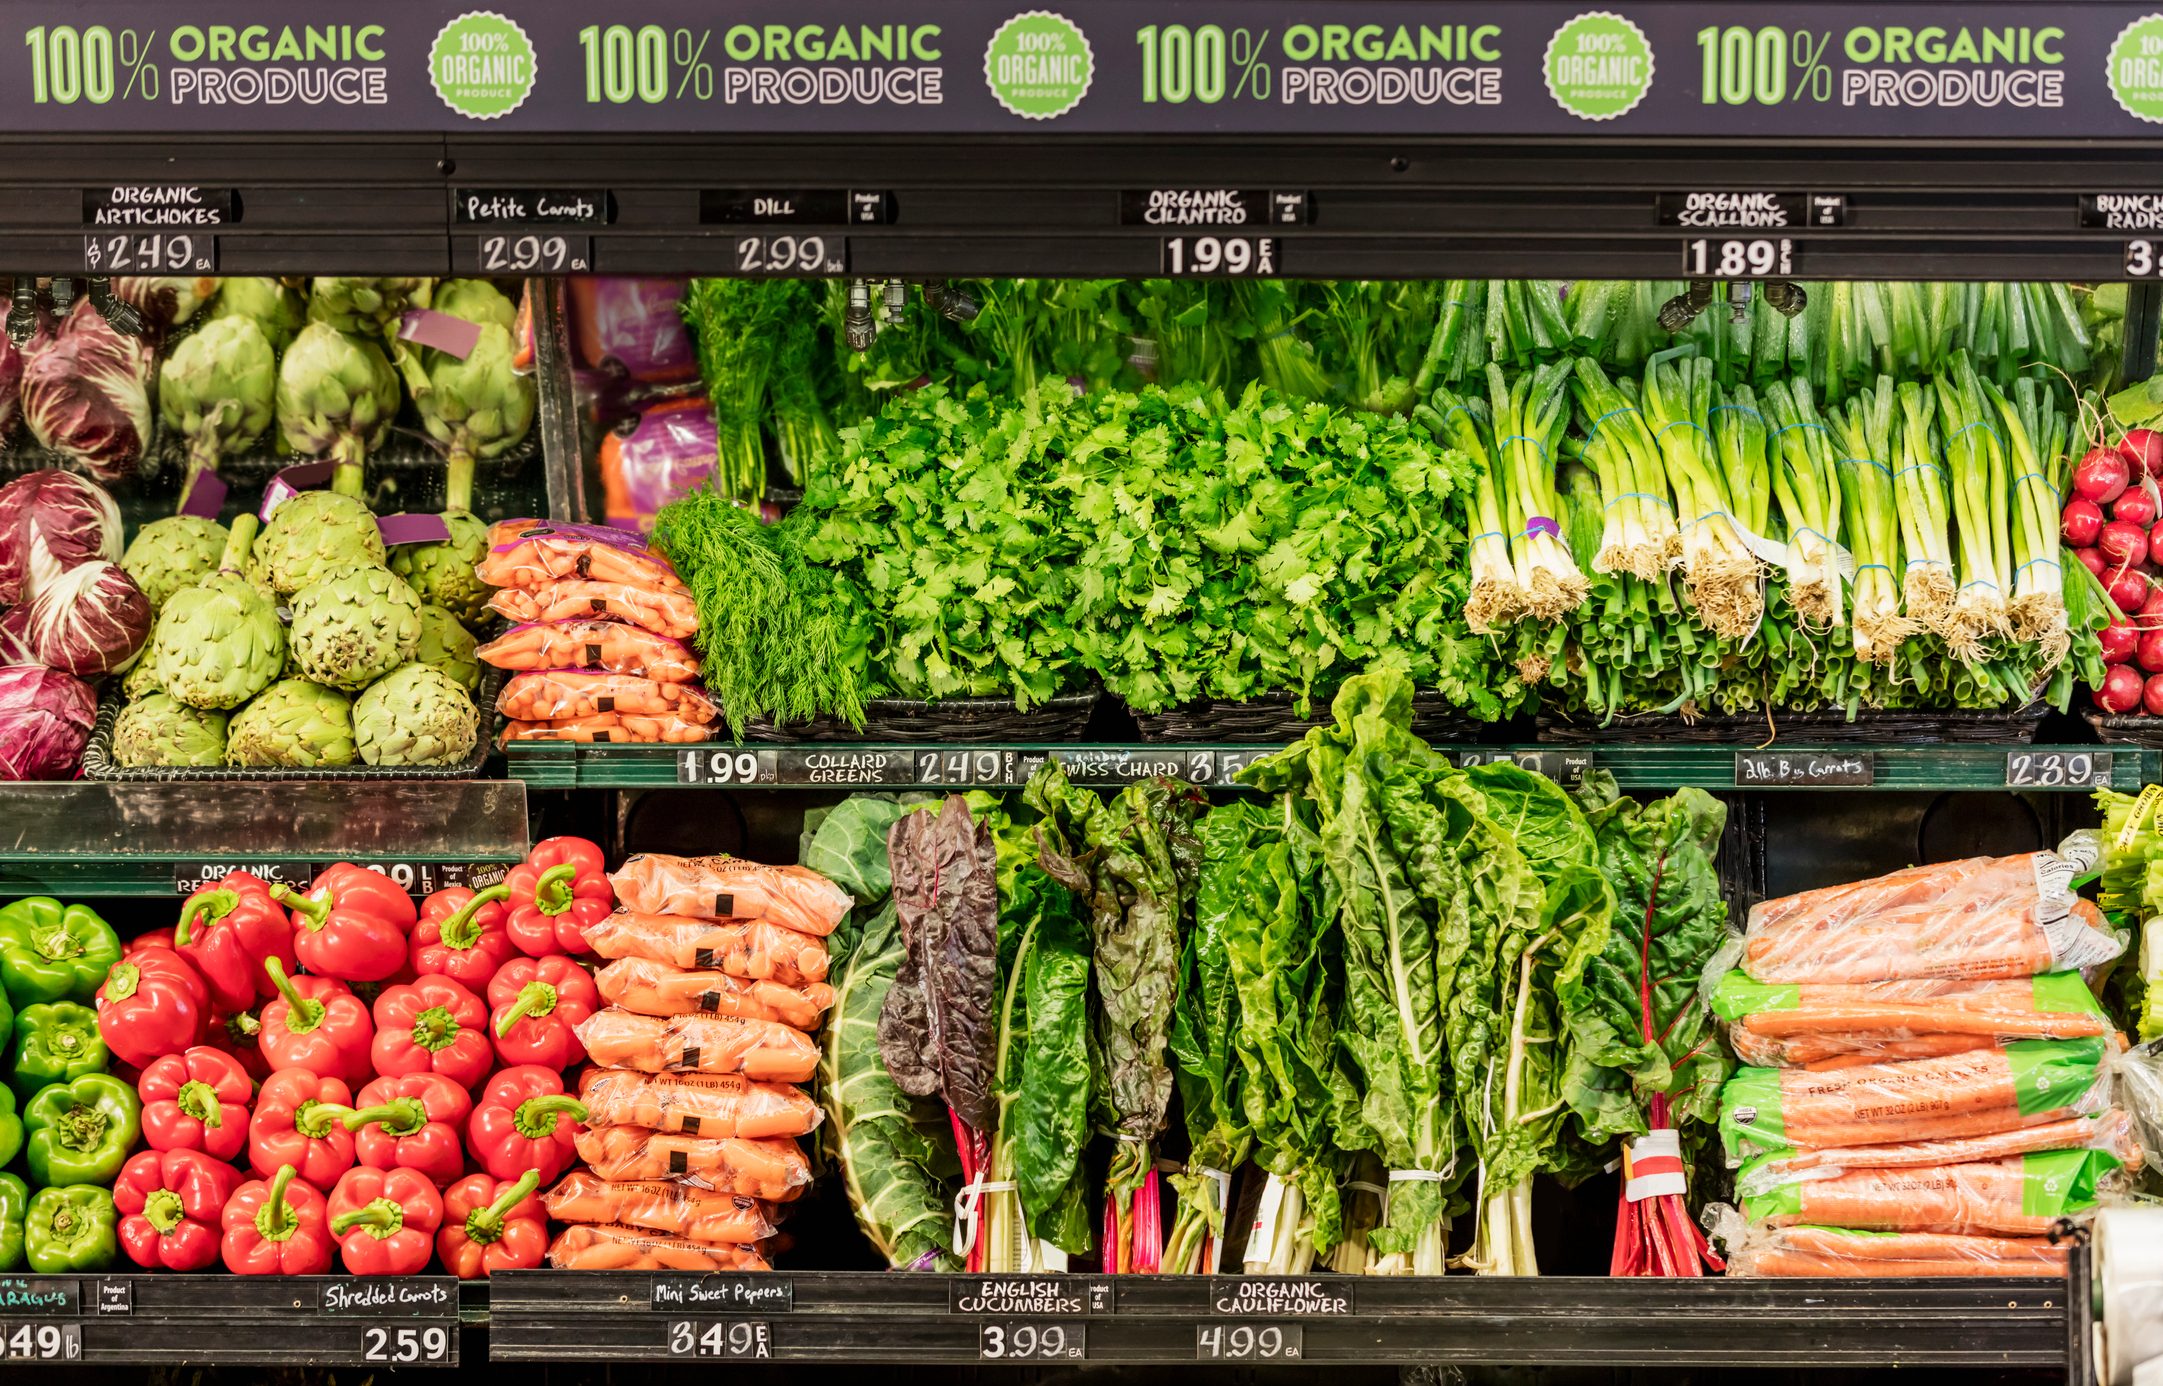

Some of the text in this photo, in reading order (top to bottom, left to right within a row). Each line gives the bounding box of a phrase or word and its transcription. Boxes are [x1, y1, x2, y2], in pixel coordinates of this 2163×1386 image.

[459, 32, 509, 52] 100%
[1016, 32, 1067, 52] 100%
[1576, 33, 1627, 53] 100%
[26, 25, 385, 104] 100% ORGANIC
[442, 54, 525, 85] ORGANIC
[579, 25, 941, 103] 100% ORGANIC
[998, 54, 1082, 85] ORGANIC
[1137, 25, 1501, 103] 100% ORGANIC
[1557, 55, 1642, 86] ORGANIC
[1697, 26, 2065, 105] 100% ORGANIC
[171, 67, 387, 104] PRODUCE
[456, 88, 512, 98] PRODUCE
[725, 67, 943, 104] PRODUCE
[1011, 88, 1068, 98] PRODUCE
[1282, 67, 1502, 104] PRODUCE
[1570, 89, 1628, 99] PRODUCE
[1842, 69, 2064, 107] PRODUCE
[111, 187, 202, 205] ORGANIC
[855, 194, 880, 203] Product
[1149, 190, 1242, 209] ORGANIC
[1276, 195, 1301, 204] Product
[1686, 193, 1780, 211] ORGANIC
[1814, 197, 1841, 206] Product
[95, 208, 221, 224] ARTICHOKES
[468, 196, 593, 220] Petite Carrots
[754, 198, 795, 216] DILL
[863, 204, 872, 212] of
[1144, 208, 1247, 224] CILANTRO
[1822, 207, 1832, 215] of
[861, 212, 874, 221] USA
[1677, 210, 1788, 227] SCALLIONS
[484, 236, 587, 270] 2.99 EA
[739, 236, 824, 271] 2.99
[1168, 237, 1273, 274] 1.99 EA
[1691, 239, 1775, 276] 1.89
[196, 259, 211, 270] EA
[685, 751, 758, 783] 1.99
[805, 754, 887, 769] COLLARD
[919, 752, 1013, 783] 2.49 BCH
[1117, 761, 1179, 777] CHARD
[1566, 757, 1587, 766] Product
[1809, 760, 1862, 778] Carrots
[2012, 754, 2108, 785] 2.39 EA
[809, 769, 883, 782] GREENS
[442, 865, 463, 873] Product
[476, 864, 498, 875] 100%
[2041, 864, 2074, 875] Calories
[421, 866, 434, 894] LB
[103, 1286, 126, 1294] Product
[111, 1294, 118, 1302] of
[325, 1283, 447, 1308] Shredded Carrots
[656, 1283, 783, 1304] Mini Sweet Peppers
[981, 1281, 1059, 1297] ENGLISH
[1090, 1285, 1109, 1293] roduct
[1095, 1293, 1101, 1301] of
[1240, 1282, 1325, 1298] ORGANIC
[101, 1302, 129, 1312] Argentina
[959, 1296, 1082, 1312] CUCUMBERS
[1092, 1301, 1104, 1309] USA
[1217, 1298, 1347, 1313] CAULIFLOWER
[66, 1335, 79, 1359] lb
[365, 1327, 447, 1361] 2.59
[671, 1321, 769, 1358] 3.49 EA
[983, 1326, 1083, 1358] 3.99 EA
[1200, 1326, 1299, 1357] 4.99 EA
